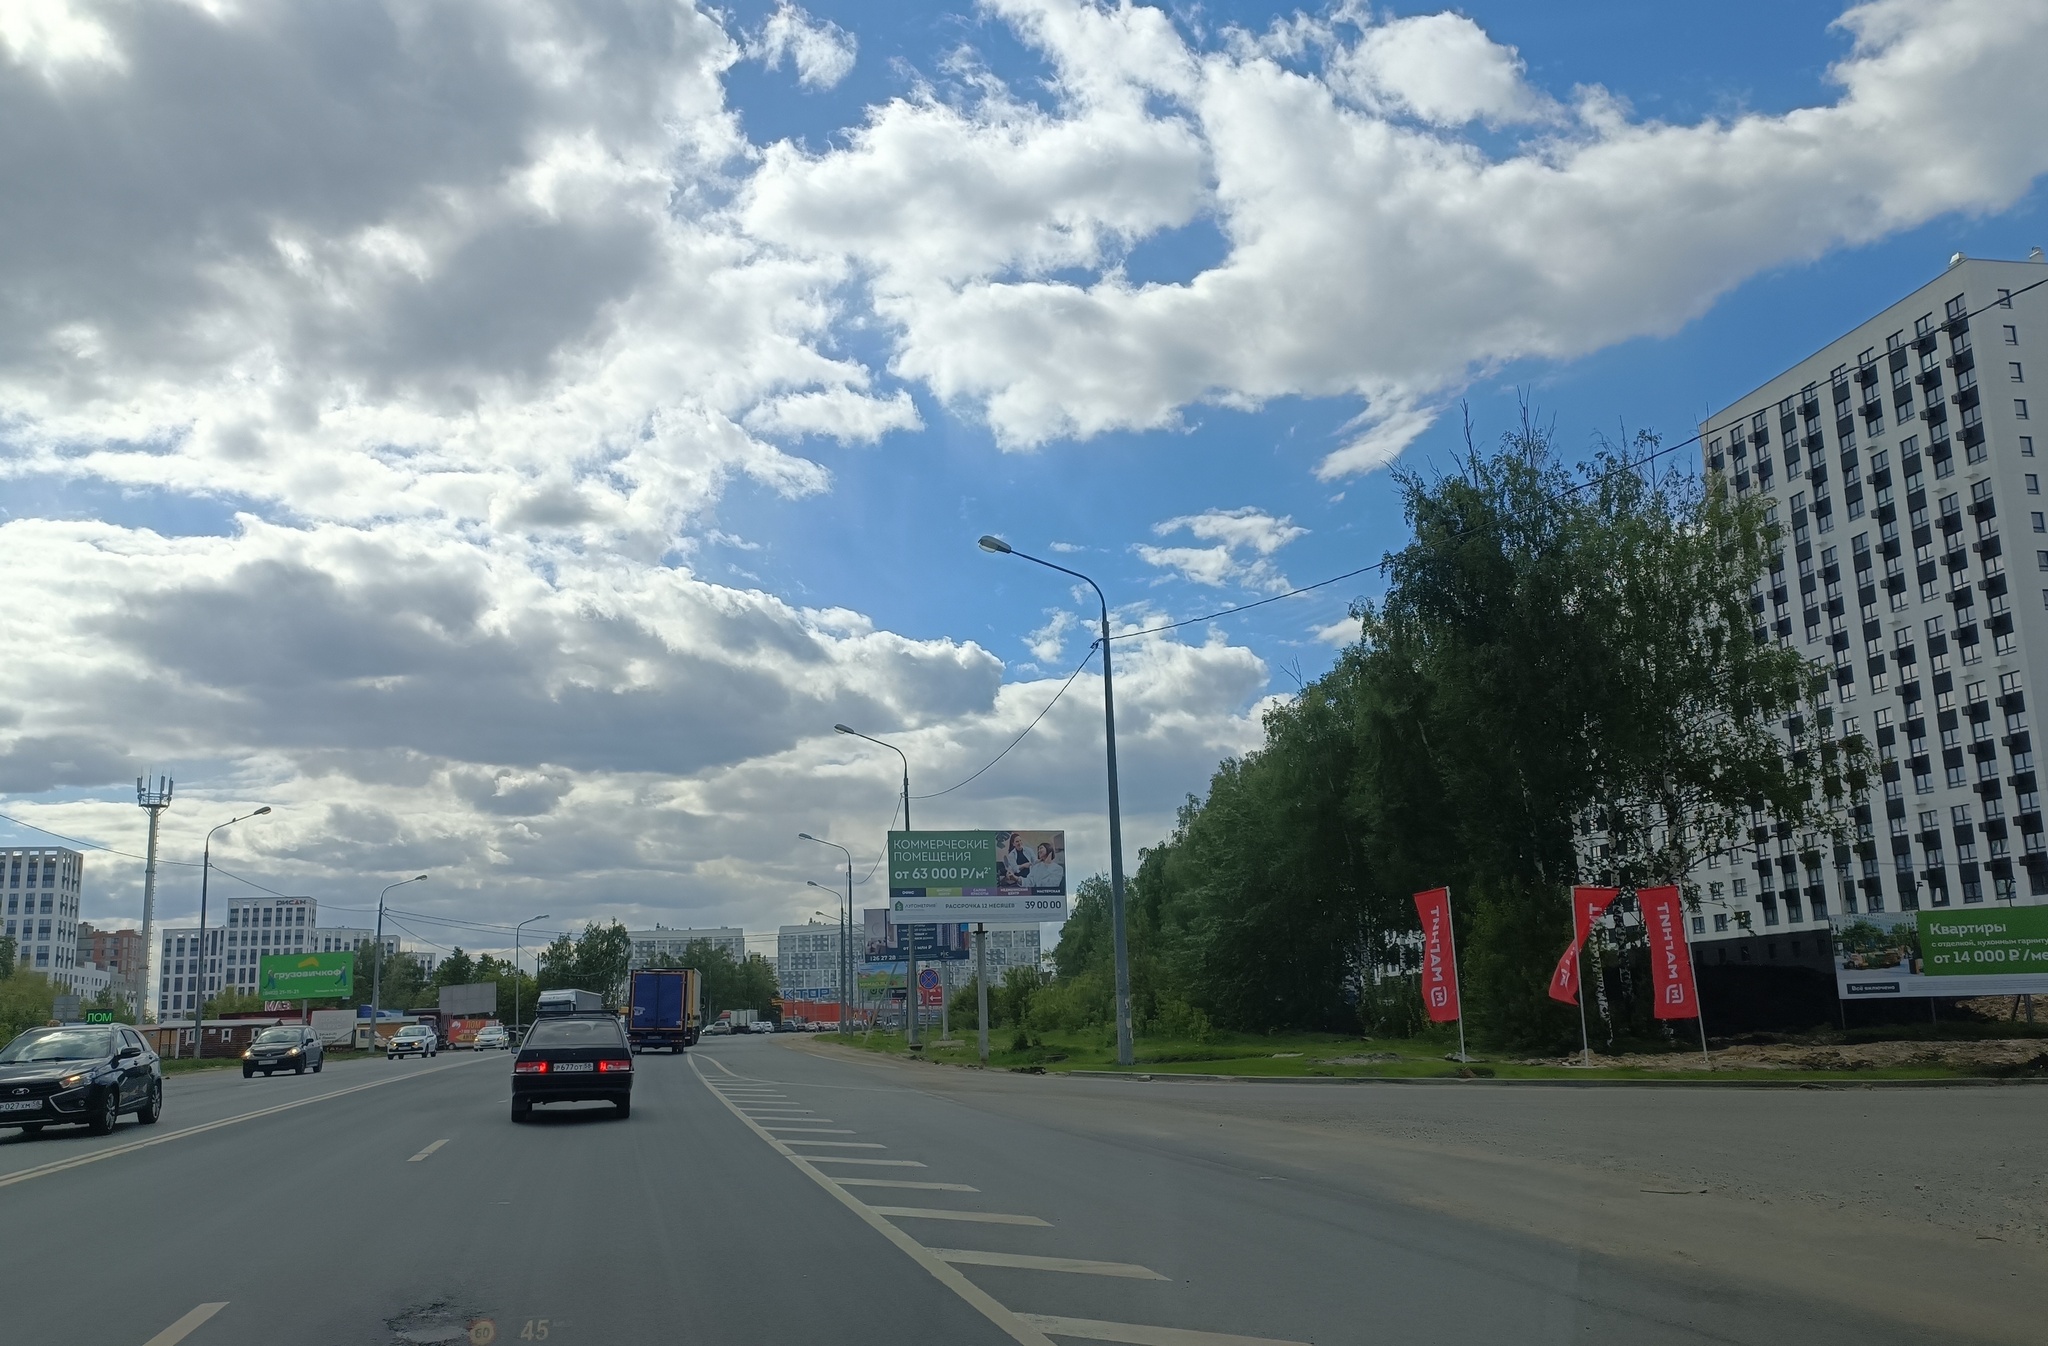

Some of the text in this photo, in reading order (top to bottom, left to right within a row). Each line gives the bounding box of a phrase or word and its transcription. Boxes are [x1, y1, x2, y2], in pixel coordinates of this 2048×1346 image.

[894, 840, 989, 850] КОММЕРЧЕСКИЕ
[894, 852, 971, 862] ПОМЕЩЕНИЯ
[894, 870, 909, 879] от
[912, 868, 928, 879] 63
[931, 867, 957, 879] 000
[1025, 901, 1061, 909] 39 00 00
[1930, 923, 2006, 937] Квартиры
[1978, 939, 2016, 947] кухонным
[1934, 955, 1950, 964] от
[1954, 951, 1970, 963] 14
[1974, 950, 2005, 962] 000
[273, 969, 342, 980] грузовичкоф
[86, 1012, 112, 1022] ЛОМ
[474, 1328, 490, 1338] 60
[520, 1320, 549, 1341] 45
